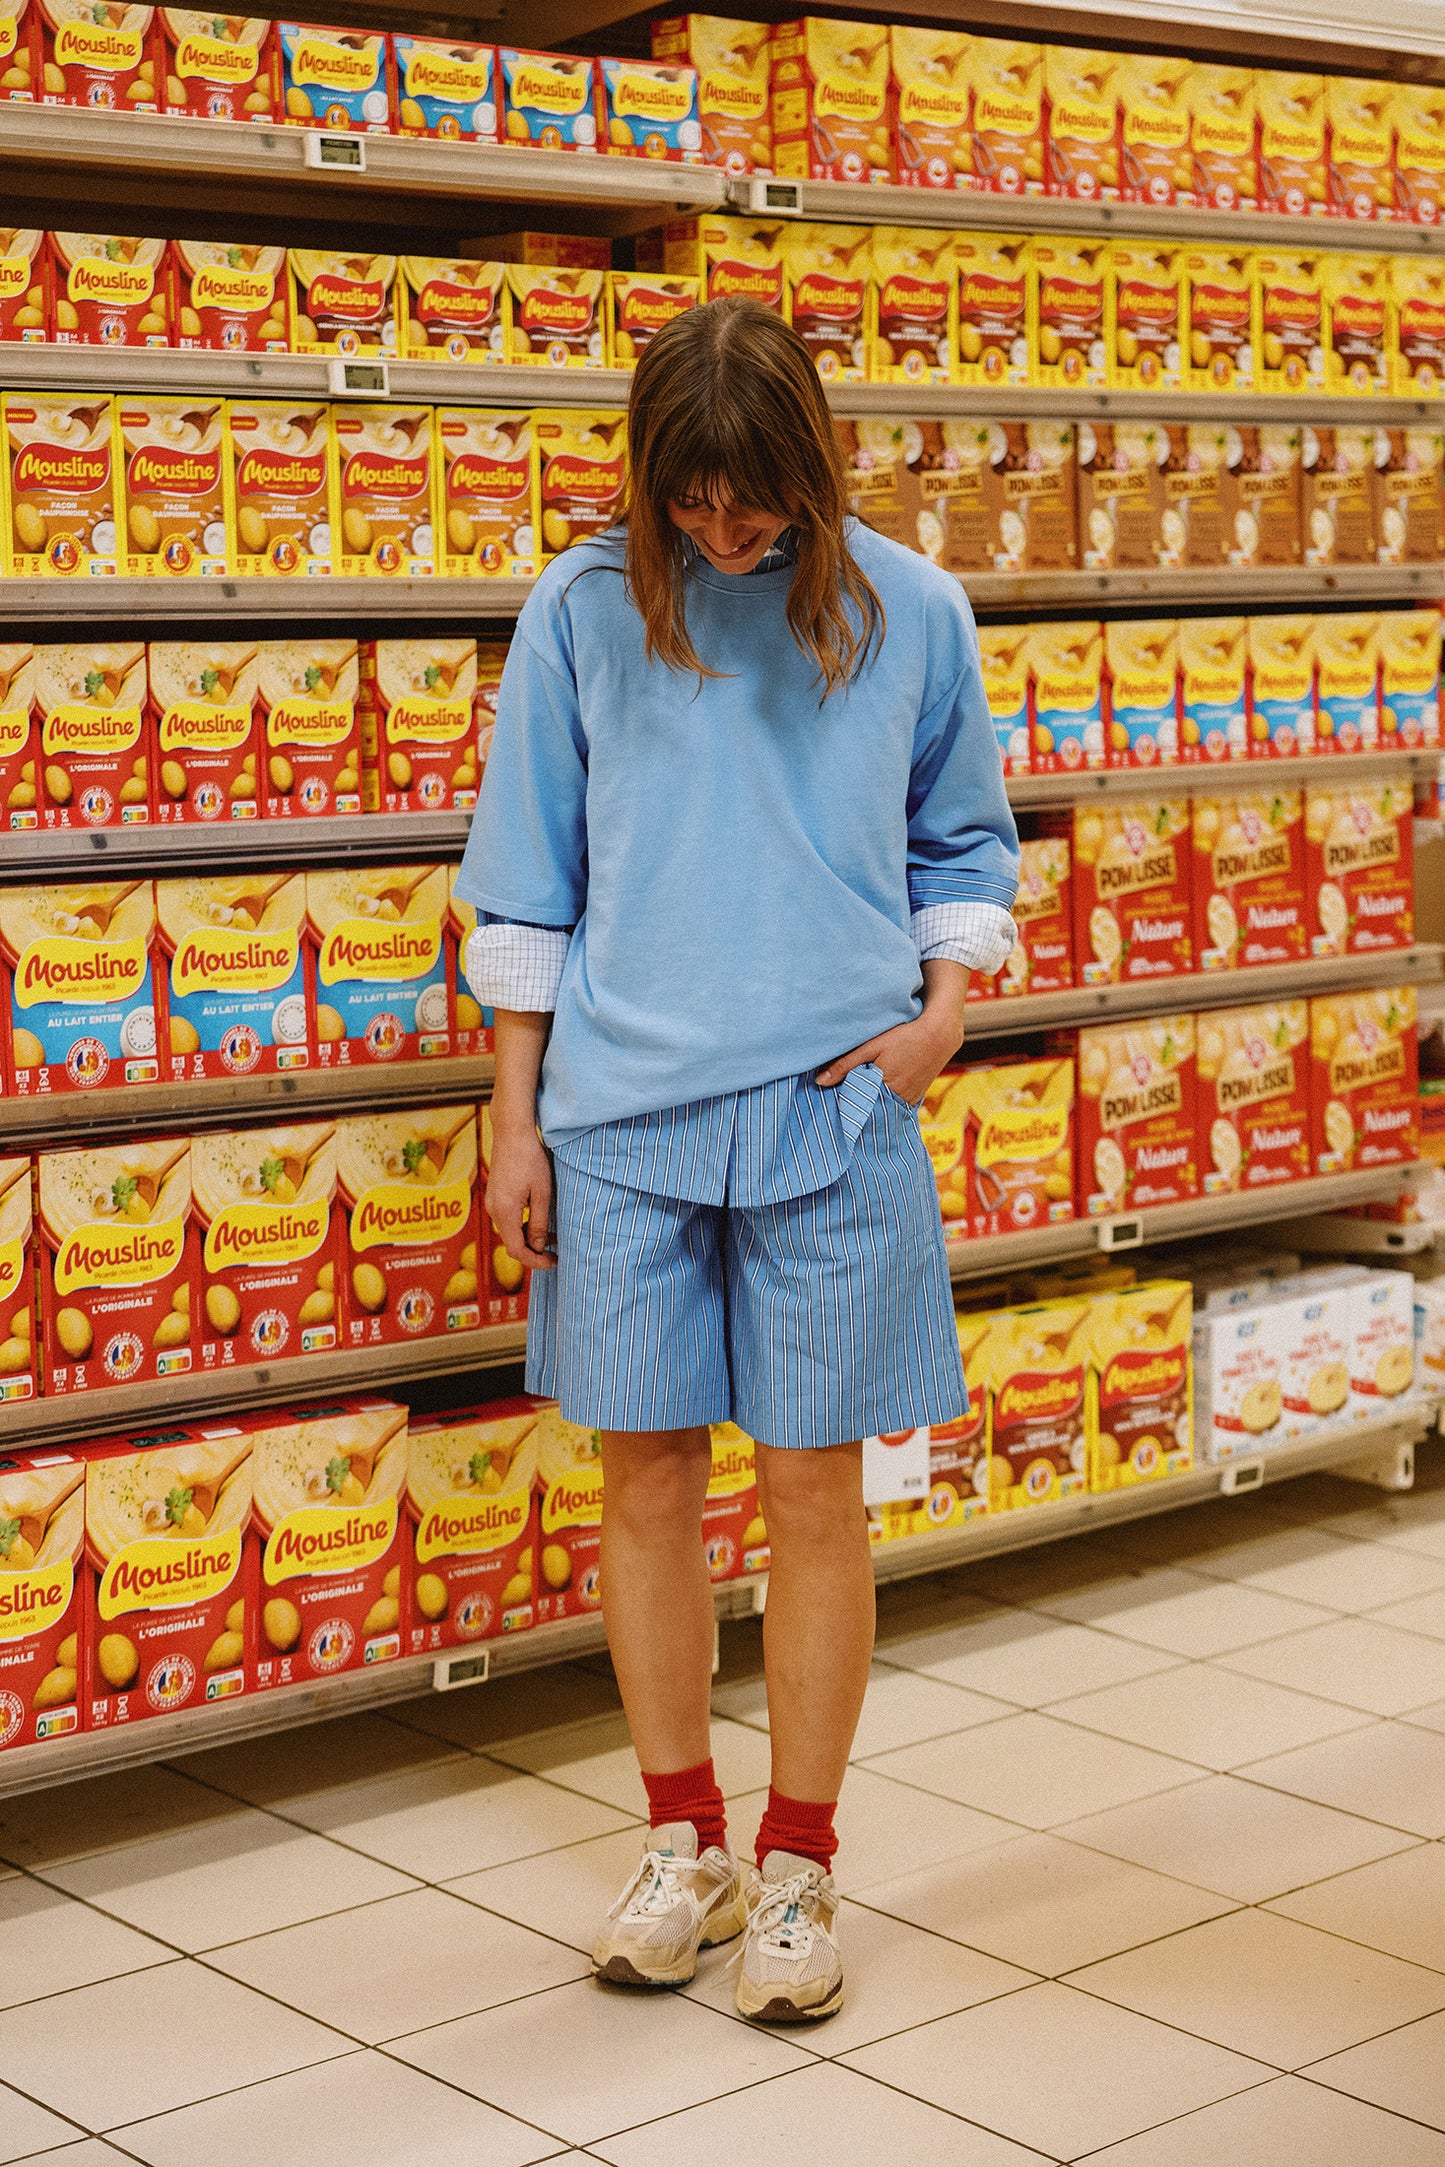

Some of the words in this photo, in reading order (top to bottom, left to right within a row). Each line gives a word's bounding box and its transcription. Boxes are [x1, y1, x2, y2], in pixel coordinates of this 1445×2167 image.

[61, 31, 136, 57] Mousline
[181, 42, 253, 69] Mousline
[299, 50, 372, 76] Mousline
[412, 62, 483, 87] Mousline
[515, 74, 582, 99] Mousline
[618, 83, 687, 106] Mousline
[74, 267, 148, 291] Mousline
[198, 275, 268, 297] Mousline
[312, 284, 380, 307] Mousline
[422, 289, 488, 313] Mousline
[525, 297, 587, 320] Mousline
[20, 453, 104, 480] Mousline
[134, 455, 215, 482] Mousline
[243, 458, 321, 484] Mousline
[348, 461, 424, 487] Mousline
[453, 464, 525, 489] Mousline
[548, 464, 619, 488] Mousline
[49, 714, 134, 742] Mousline
[167, 713, 244, 738] Mousline
[274, 708, 347, 733] Mousline
[393, 706, 465, 730] Mousline
[181, 942, 290, 978] Mousline
[329, 933, 433, 967] Mousline
[25, 952, 138, 989] Mousline
[203, 1006, 217, 1015] AU
[219, 1004, 240, 1014] LAIT
[242, 1001, 274, 1012] ENTIER
[349, 995, 362, 1003] AU
[364, 993, 384, 1002] LAIT
[48, 1018, 62, 1028] AU
[64, 1017, 87, 1026] LAIT
[89, 1014, 123, 1024] ENTIER
[359, 1195, 463, 1233] Mousline
[214, 1215, 319, 1255] Mousline
[64, 1234, 175, 1277] Mousline
[386, 1254, 442, 1271] L'ORIGINALE
[240, 1274, 298, 1293] L'ORIGINALE
[91, 1296, 153, 1315] L'ORIGINALE
[551, 1486, 605, 1516] Mous
[425, 1505, 521, 1545] Mousline
[275, 1518, 388, 1565] Mousline
[110, 1549, 231, 1599] Mousline
[0, 1581, 63, 1617] sline
[301, 1582, 364, 1605] L'ORIGINALE
[138, 1616, 205, 1640] L'ORIGINALE
